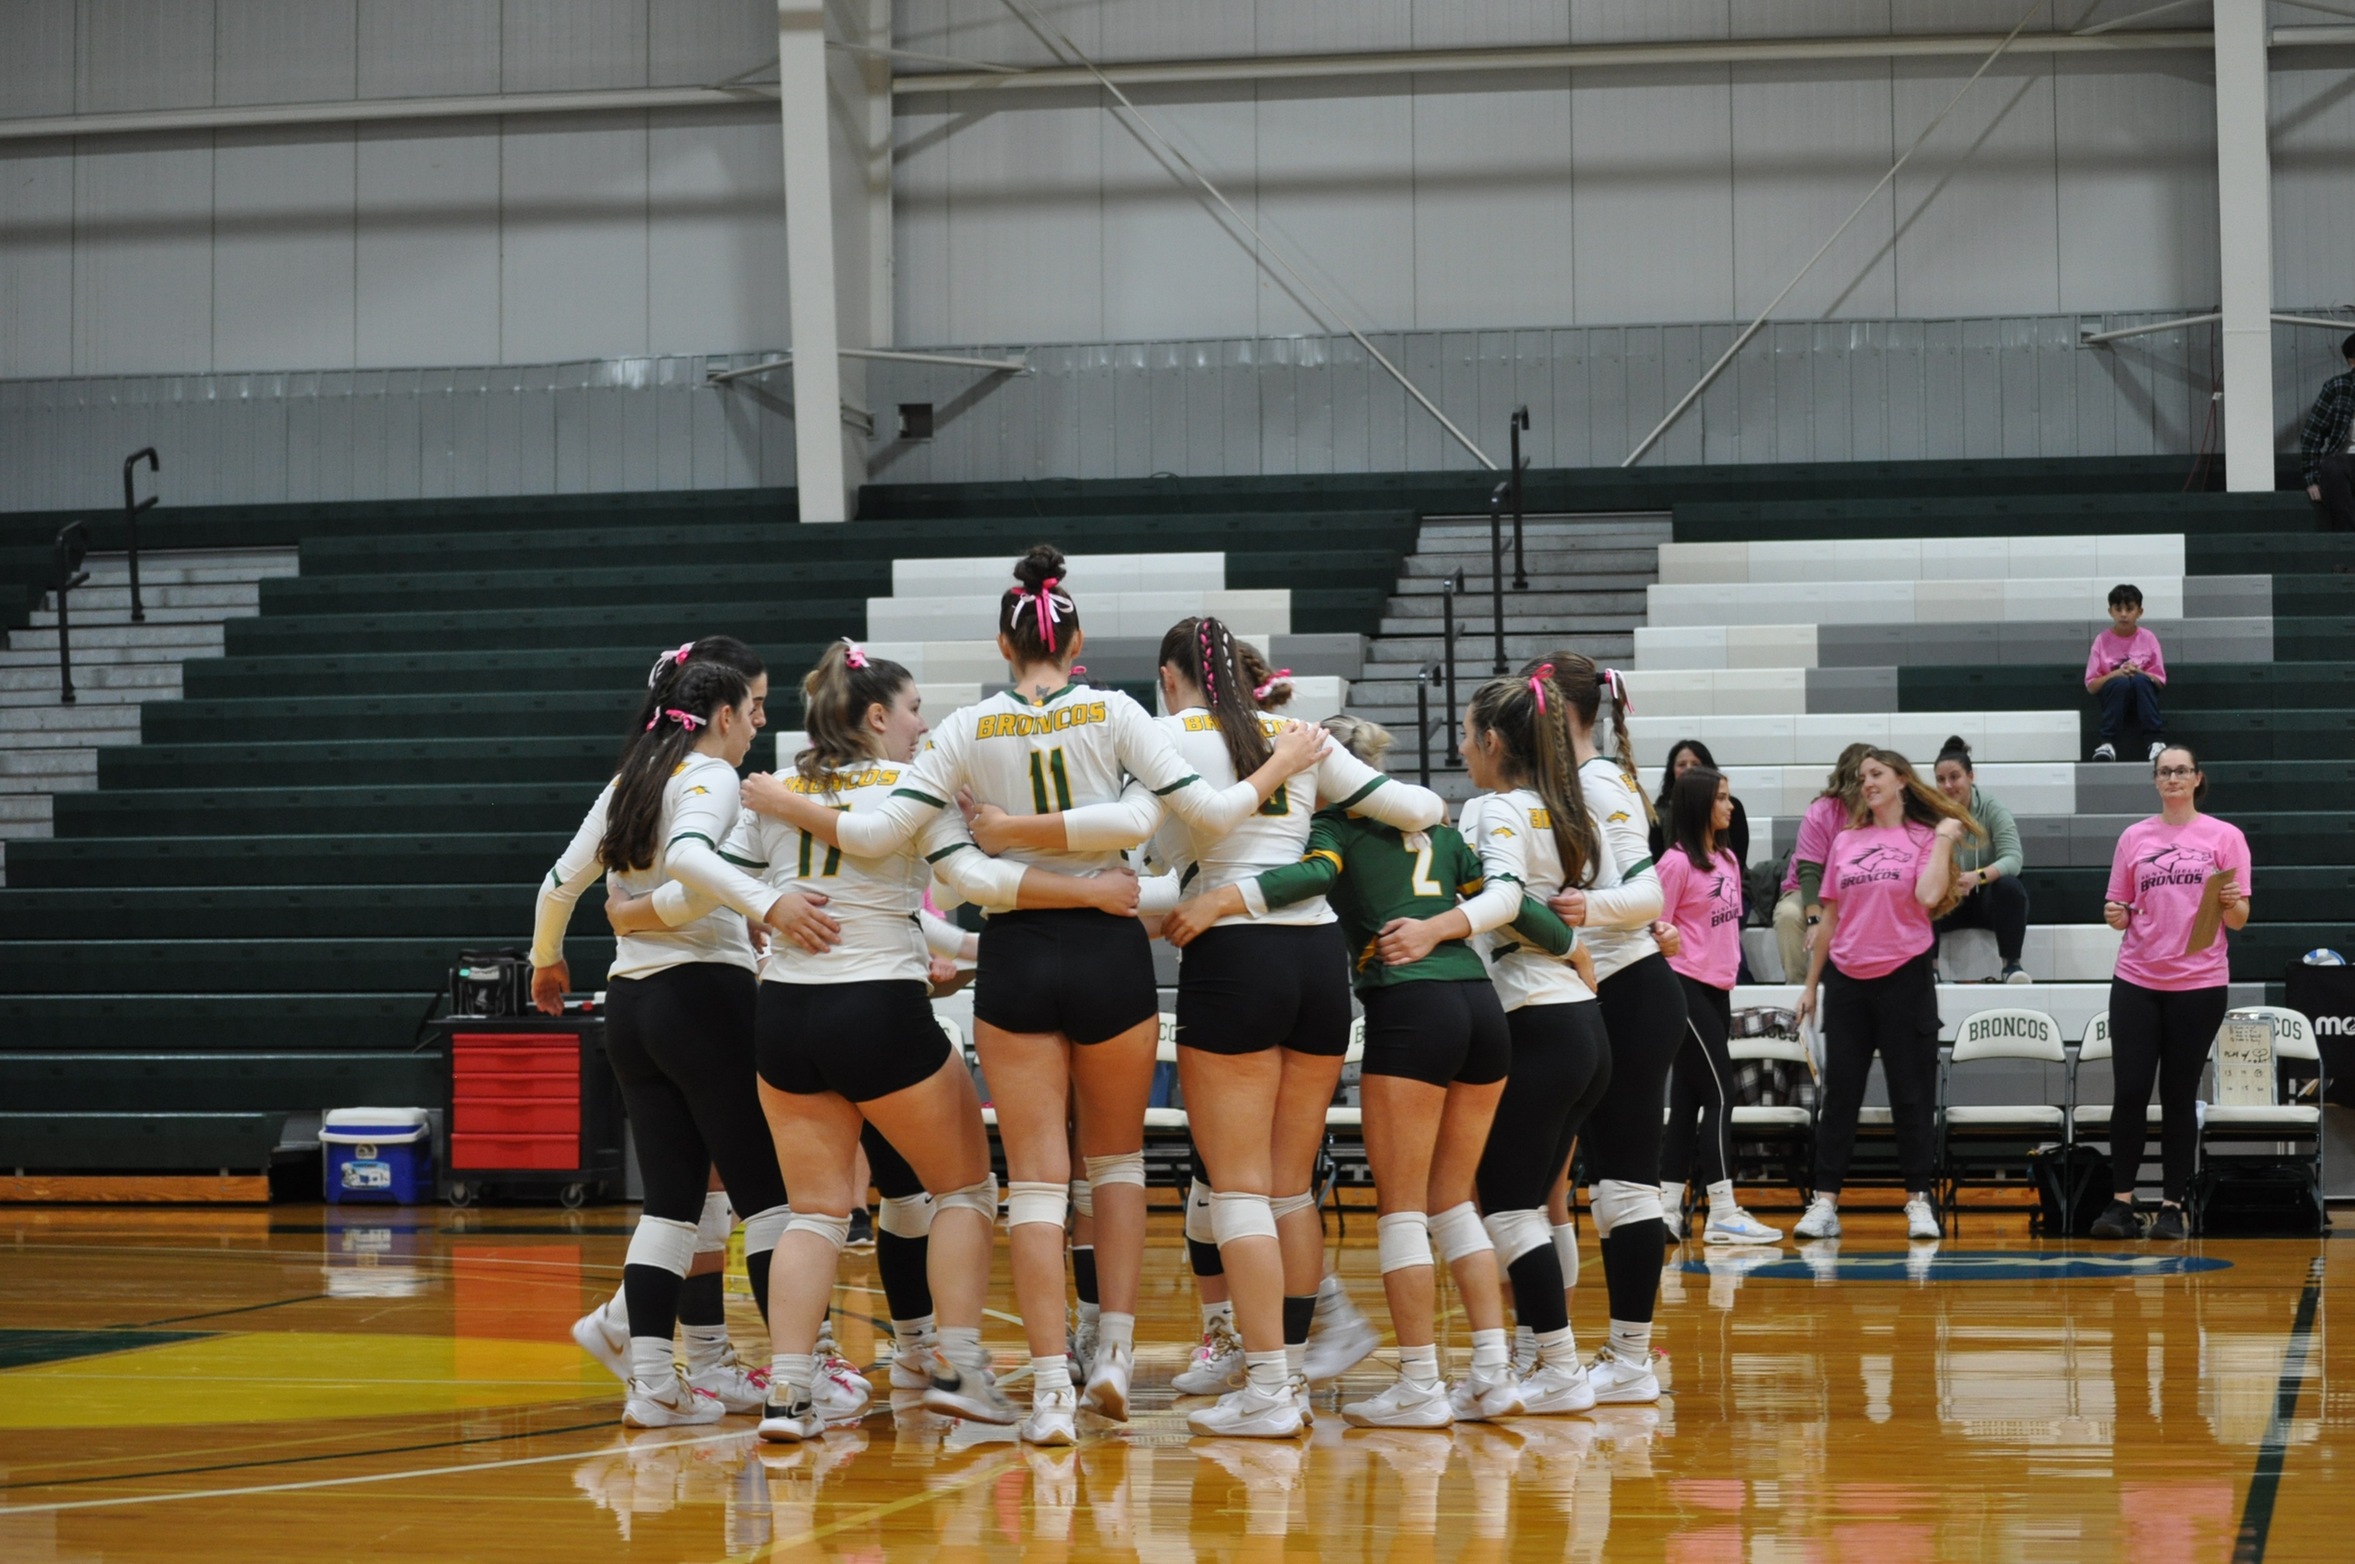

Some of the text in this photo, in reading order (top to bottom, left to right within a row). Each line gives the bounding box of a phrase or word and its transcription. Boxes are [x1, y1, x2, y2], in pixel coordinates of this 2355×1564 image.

[975, 700, 1106, 741] BRONCOS
[1028, 744, 1075, 815] 11
[1401, 831, 1442, 896] 2
[1840, 871, 1900, 889] BRONCOS
[2140, 873, 2203, 893] BRONCOS
[1969, 1017, 2049, 1042] BRONCOS
